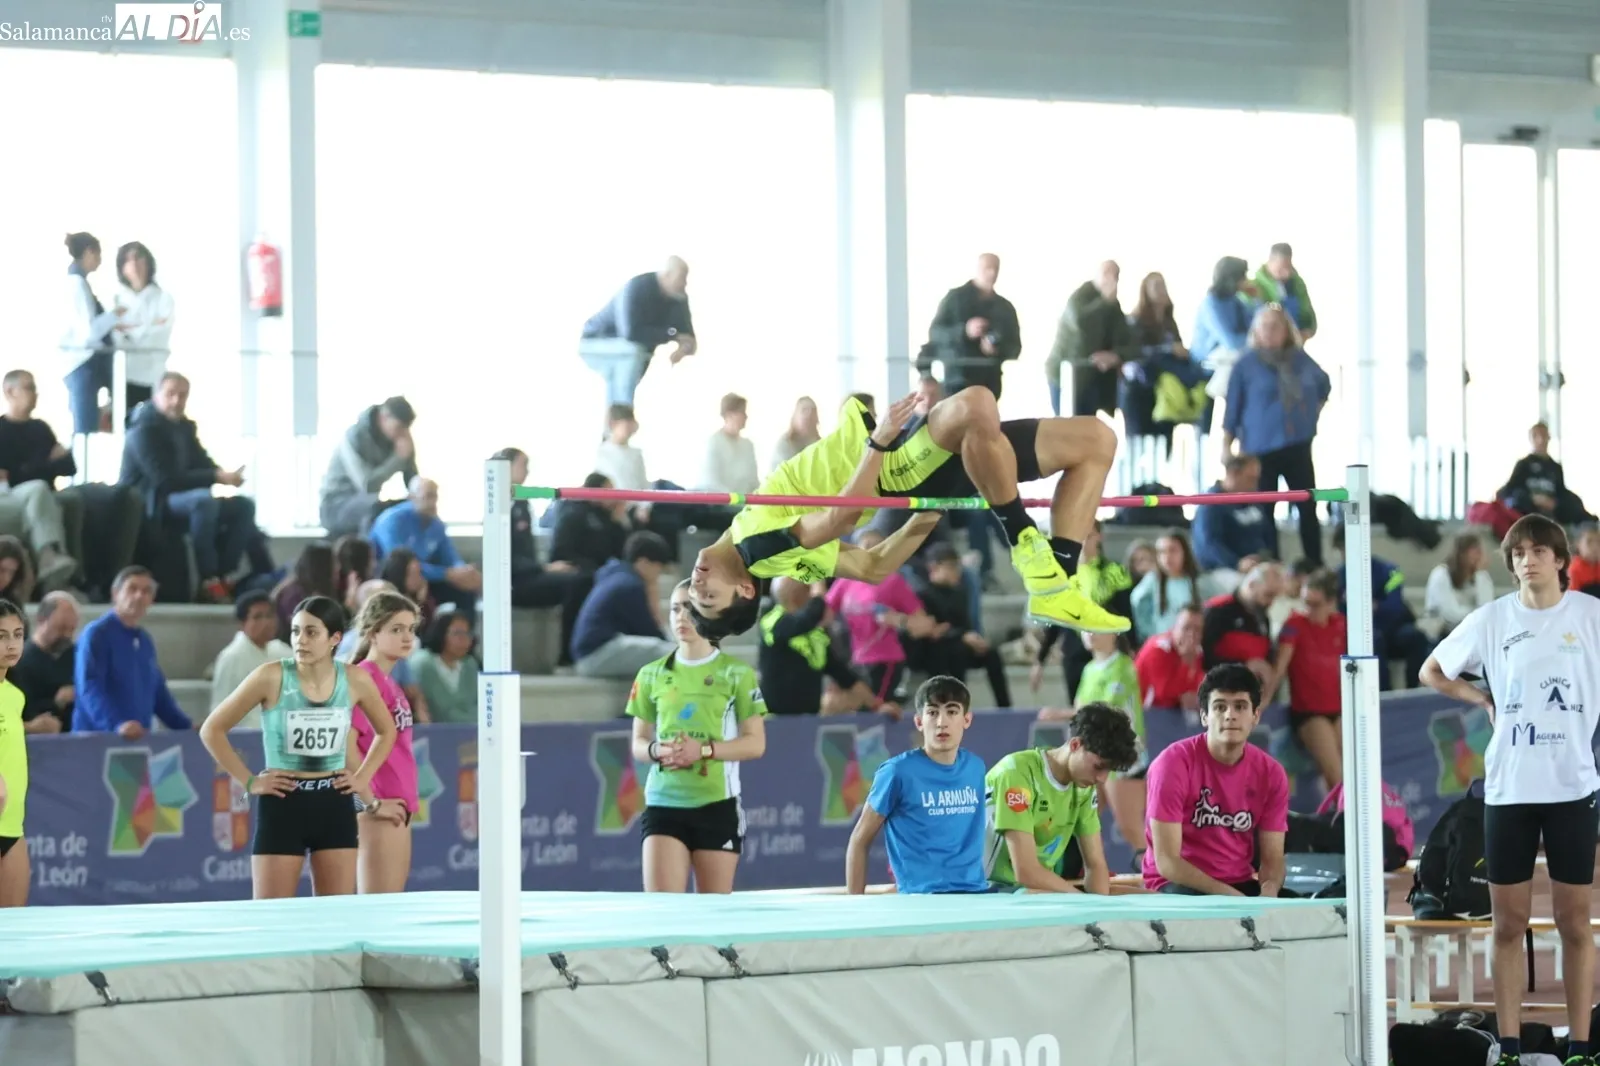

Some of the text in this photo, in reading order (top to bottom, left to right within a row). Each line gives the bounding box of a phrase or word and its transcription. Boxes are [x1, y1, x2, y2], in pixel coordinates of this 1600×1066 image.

[485, 689, 494, 728] MONDO
[293, 727, 339, 750] 2657
[921, 786, 979, 807] LA ARMUÑA
[928, 808, 945, 816] CLUB
[61, 830, 88, 858] de
[38, 860, 89, 888] León
[204, 855, 252, 882] Casti
